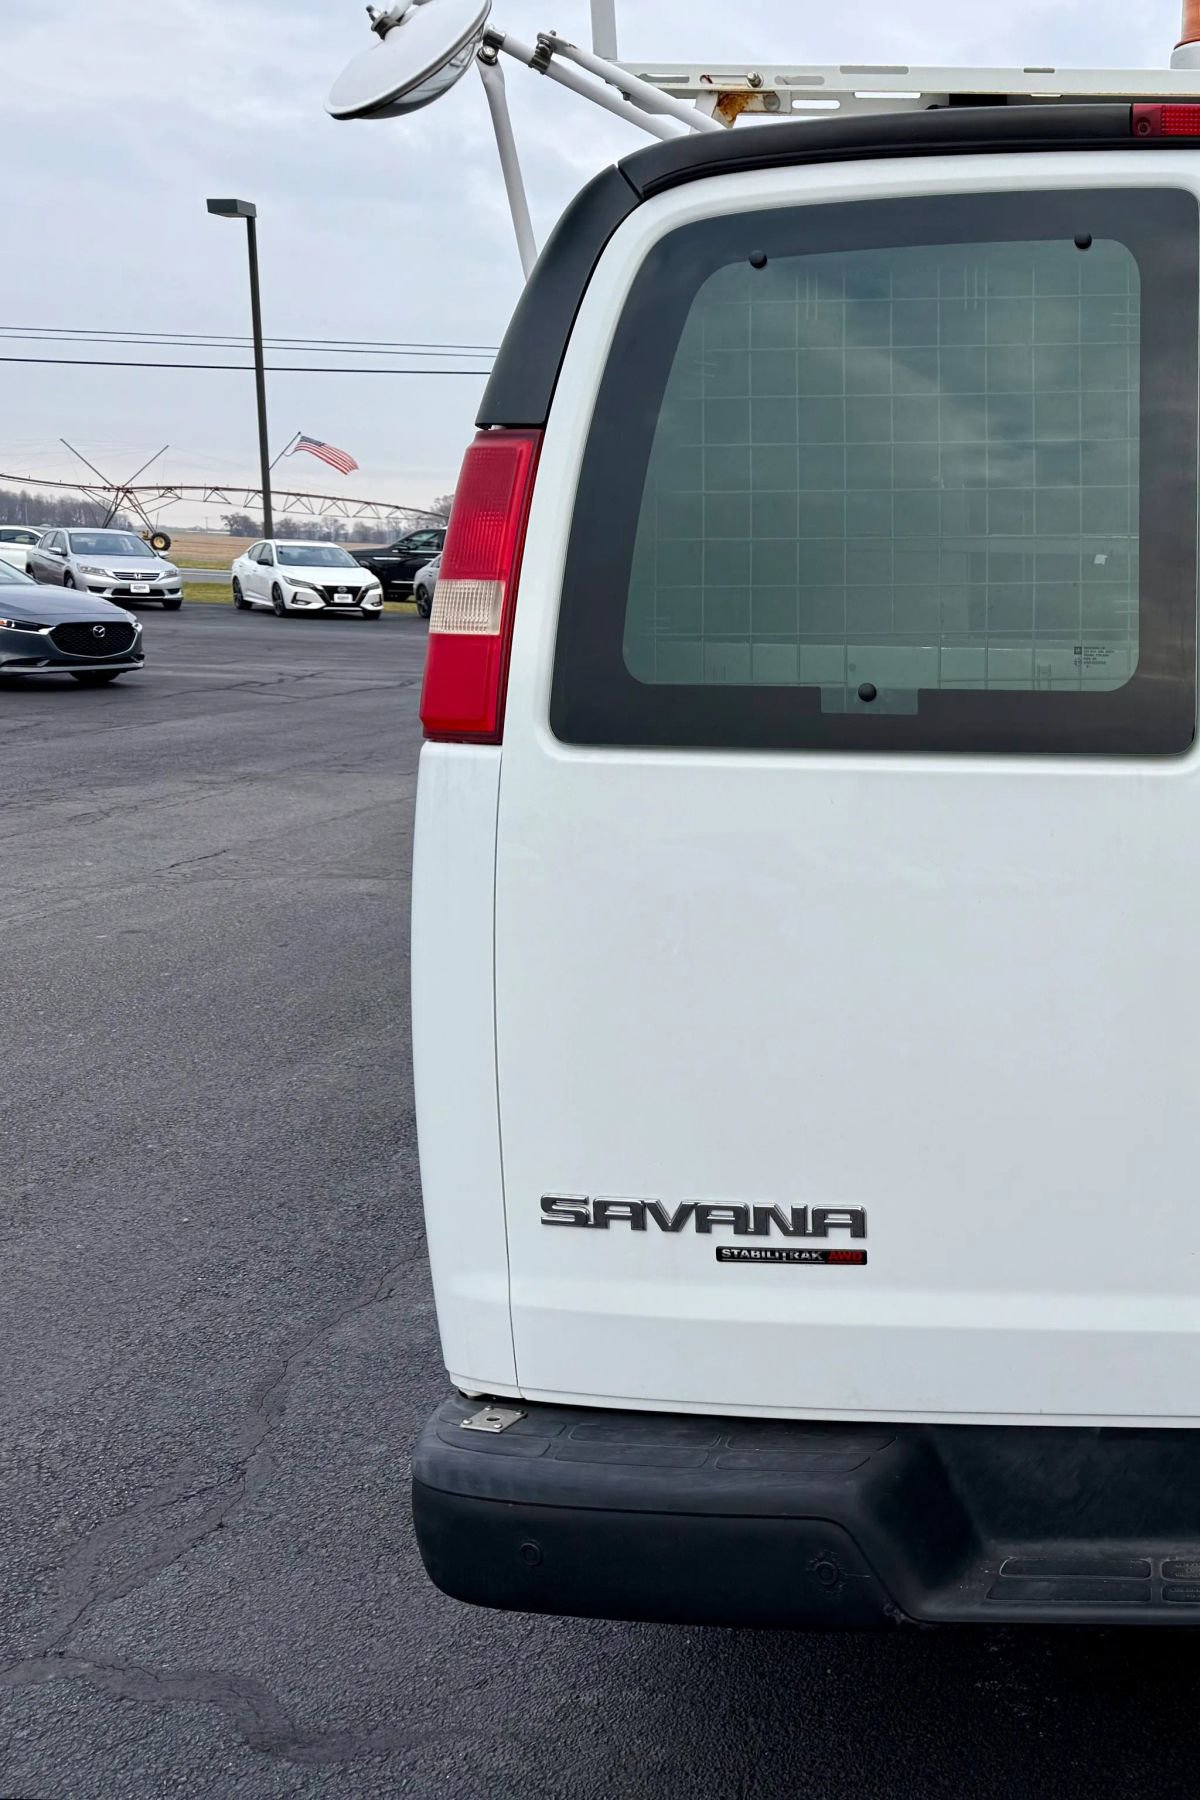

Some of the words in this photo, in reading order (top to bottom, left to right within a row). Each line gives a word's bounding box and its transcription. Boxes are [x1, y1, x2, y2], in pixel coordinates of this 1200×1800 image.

[540, 1192, 868, 1239] SAVANA
[721, 1248, 823, 1261] STABILITRAK
[828, 1250, 863, 1262] AWD
